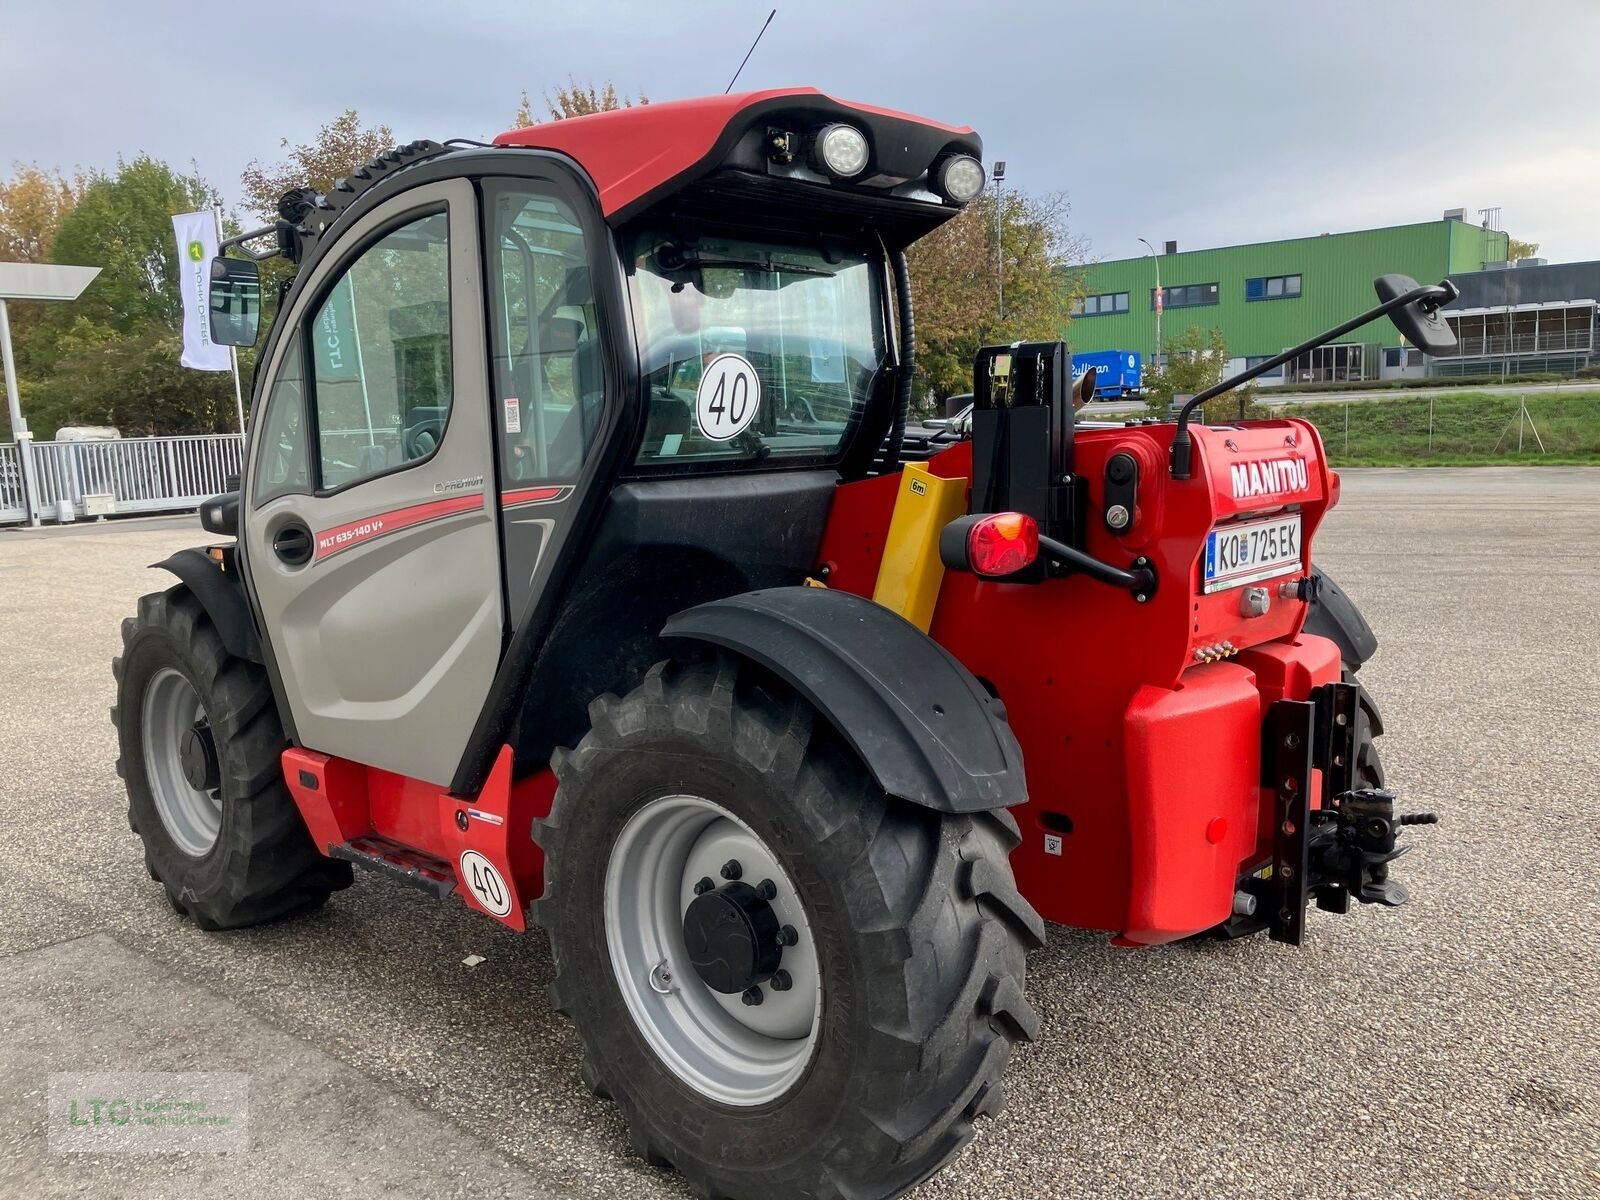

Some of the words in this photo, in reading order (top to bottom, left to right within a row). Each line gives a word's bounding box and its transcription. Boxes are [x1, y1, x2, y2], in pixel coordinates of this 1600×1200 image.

[708, 371, 748, 425] 40
[444, 476, 483, 491] PREMIUM
[912, 481, 924, 493] 6m
[1230, 457, 1307, 498] MANITOU
[320, 536, 335, 549] MLT
[336, 524, 371, 543] 635-140
[371, 520, 383, 531] V+
[1219, 535, 1239, 571] KO
[1251, 527, 1277, 564] 725
[1280, 523, 1296, 557] EK
[1208, 562, 1213, 572] A
[473, 862, 503, 906] 40
